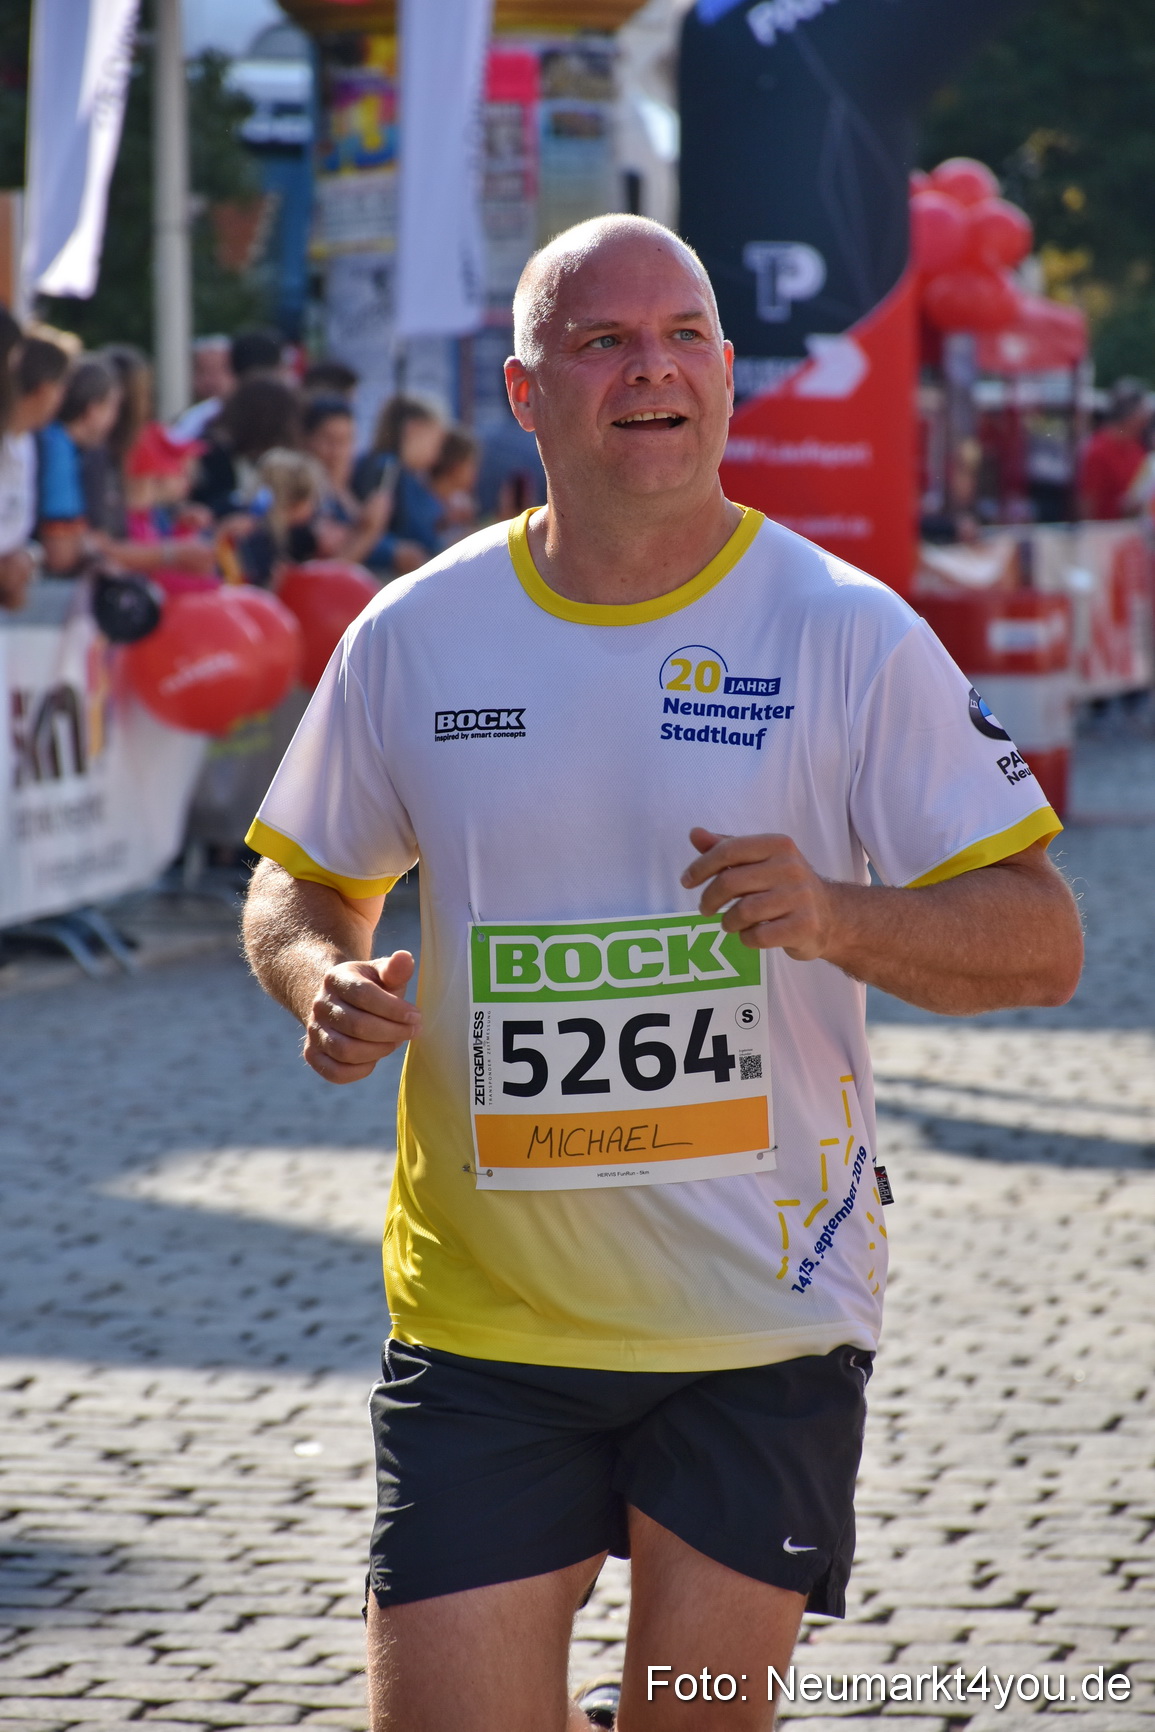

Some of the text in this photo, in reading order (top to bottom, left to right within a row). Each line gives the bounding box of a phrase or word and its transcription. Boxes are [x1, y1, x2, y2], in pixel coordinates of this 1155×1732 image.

[666, 658, 776, 693] 20 JAHRE
[436, 709, 525, 733] BOCK
[663, 697, 795, 721] Neumarkter
[435, 730, 526, 742] inspired by smart concepts
[660, 722, 767, 750] Stadtlauf
[996, 749, 1027, 775] PA
[491, 925, 737, 991] BOCK
[741, 1009, 754, 1023] S
[502, 1007, 736, 1098] 5264
[527, 1124, 693, 1159] MICHAEL
[852, 1145, 867, 1184] 2019
